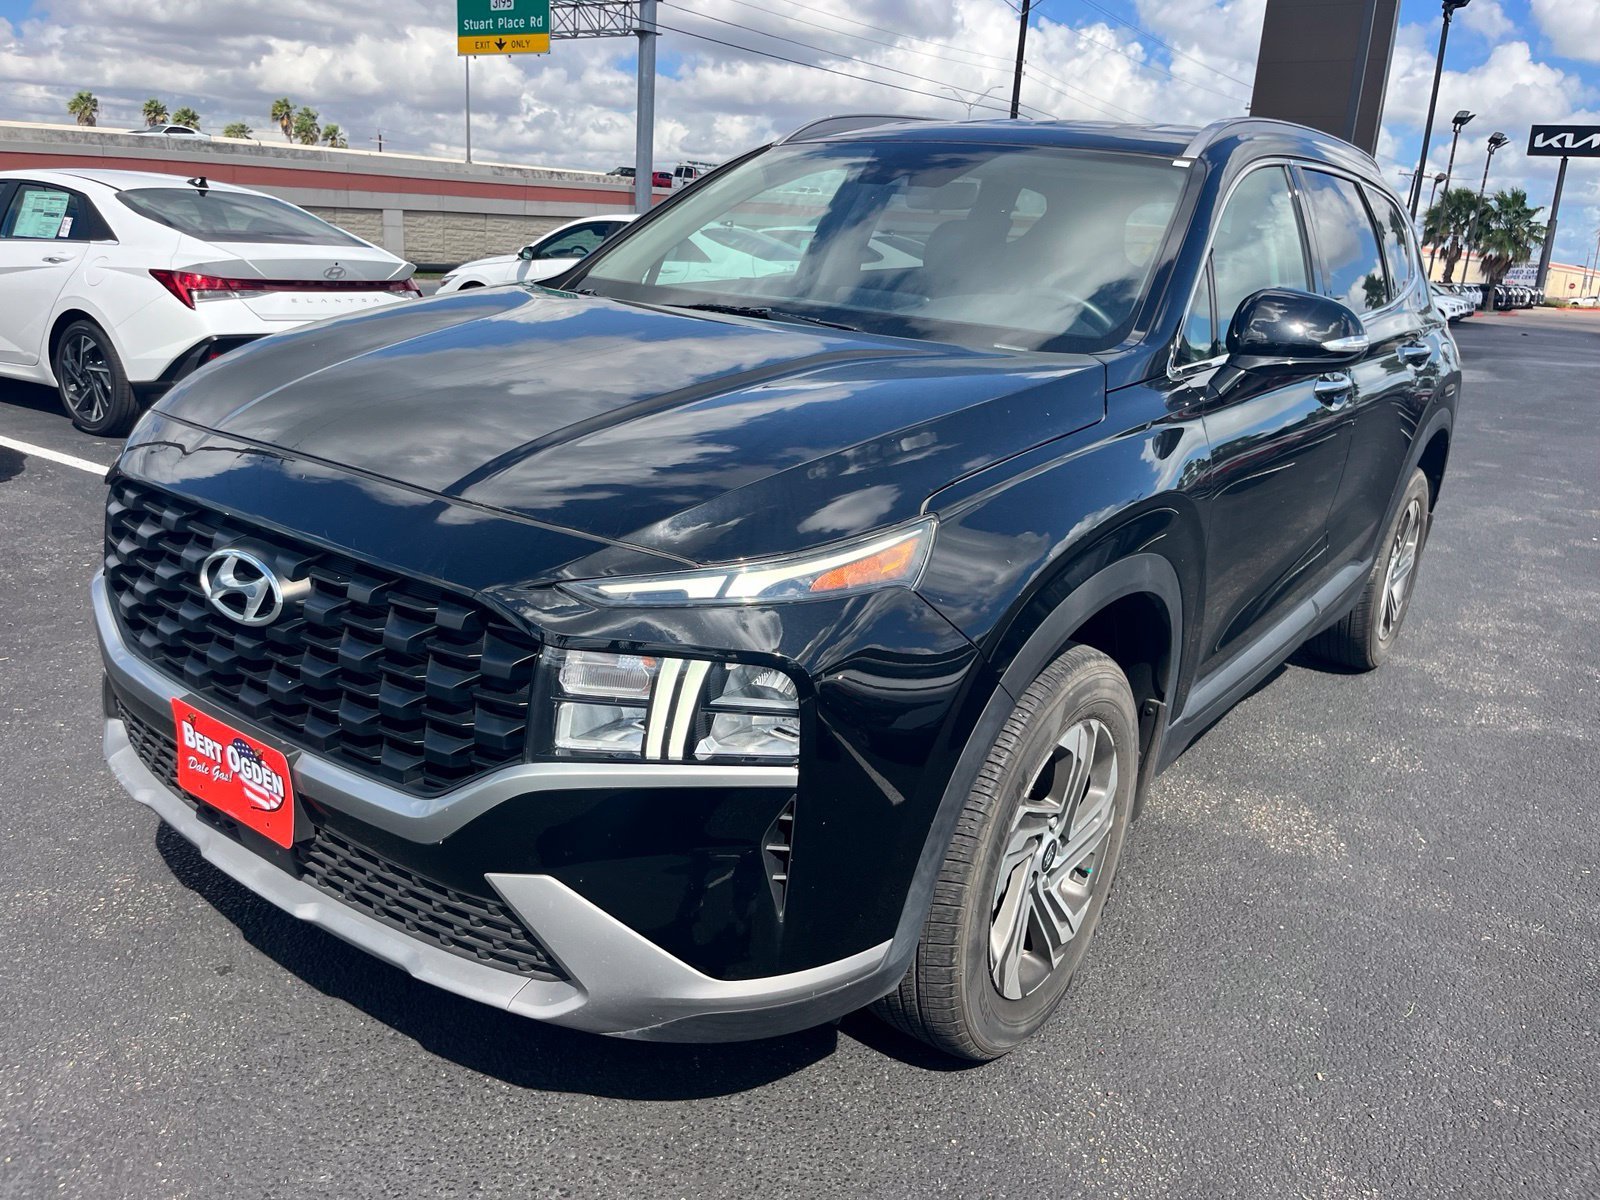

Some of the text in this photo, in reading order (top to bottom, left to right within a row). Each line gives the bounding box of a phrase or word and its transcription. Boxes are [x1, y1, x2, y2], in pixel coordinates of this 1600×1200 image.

[463, 16, 543, 30] Stuart Place Rd
[475, 40, 531, 49] EXIT ONLY
[182, 720, 285, 798] BERT OGDEN
[188, 756, 233, 783] Dale Gas!
